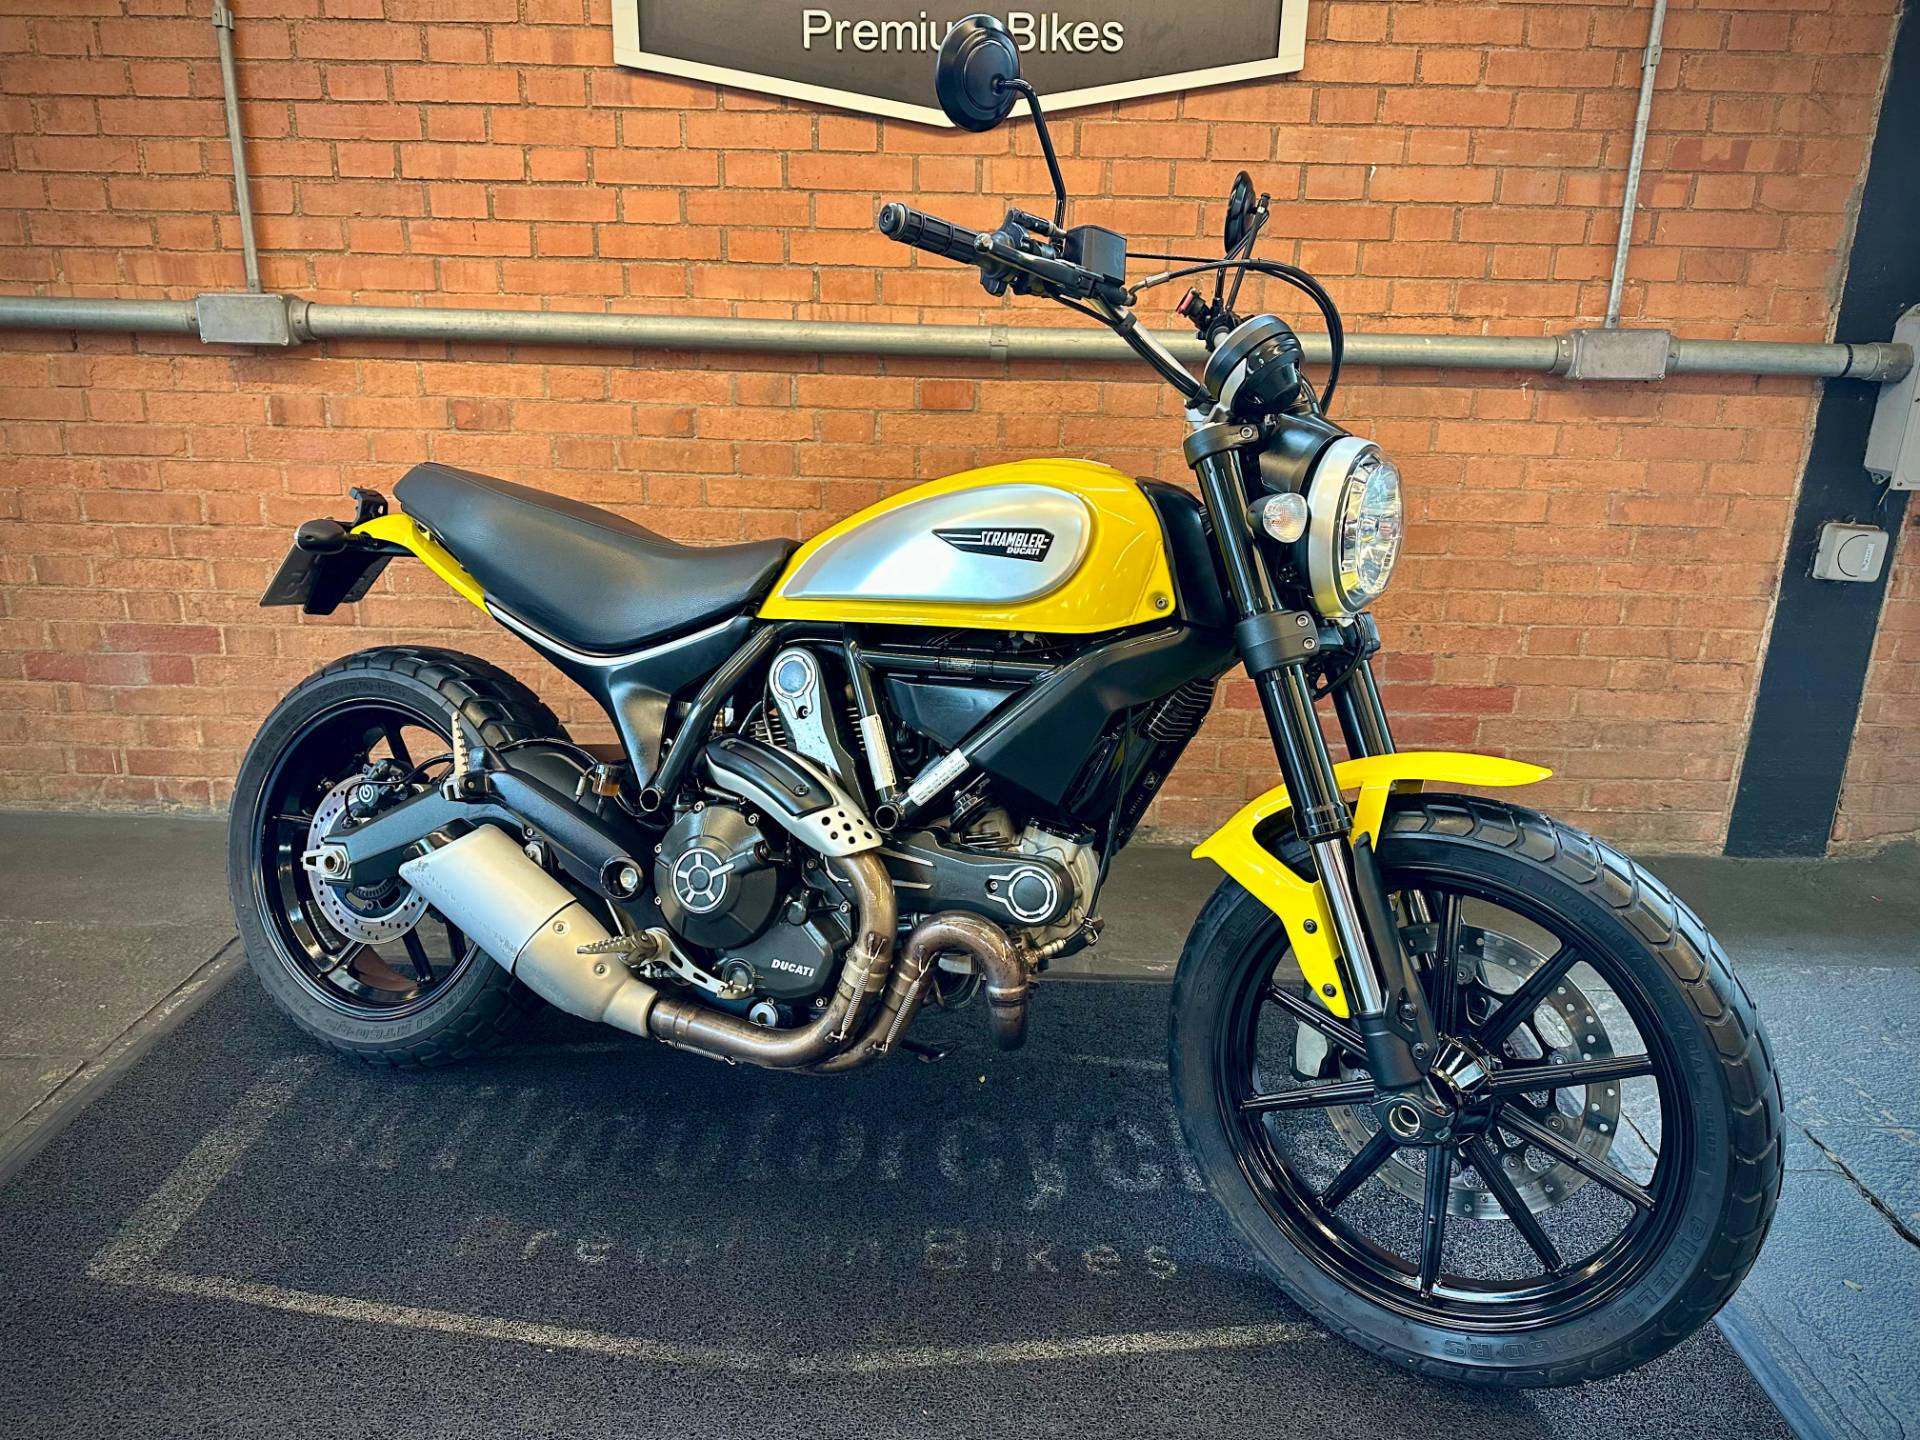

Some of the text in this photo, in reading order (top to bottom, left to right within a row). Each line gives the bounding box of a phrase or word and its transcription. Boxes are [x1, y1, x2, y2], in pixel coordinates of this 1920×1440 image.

[803, 10, 953, 51] Premiu
[981, 531, 1047, 549] SCRAMBLER
[1006, 547, 1040, 555] DUCATI
[771, 959, 814, 977] DUCATI
